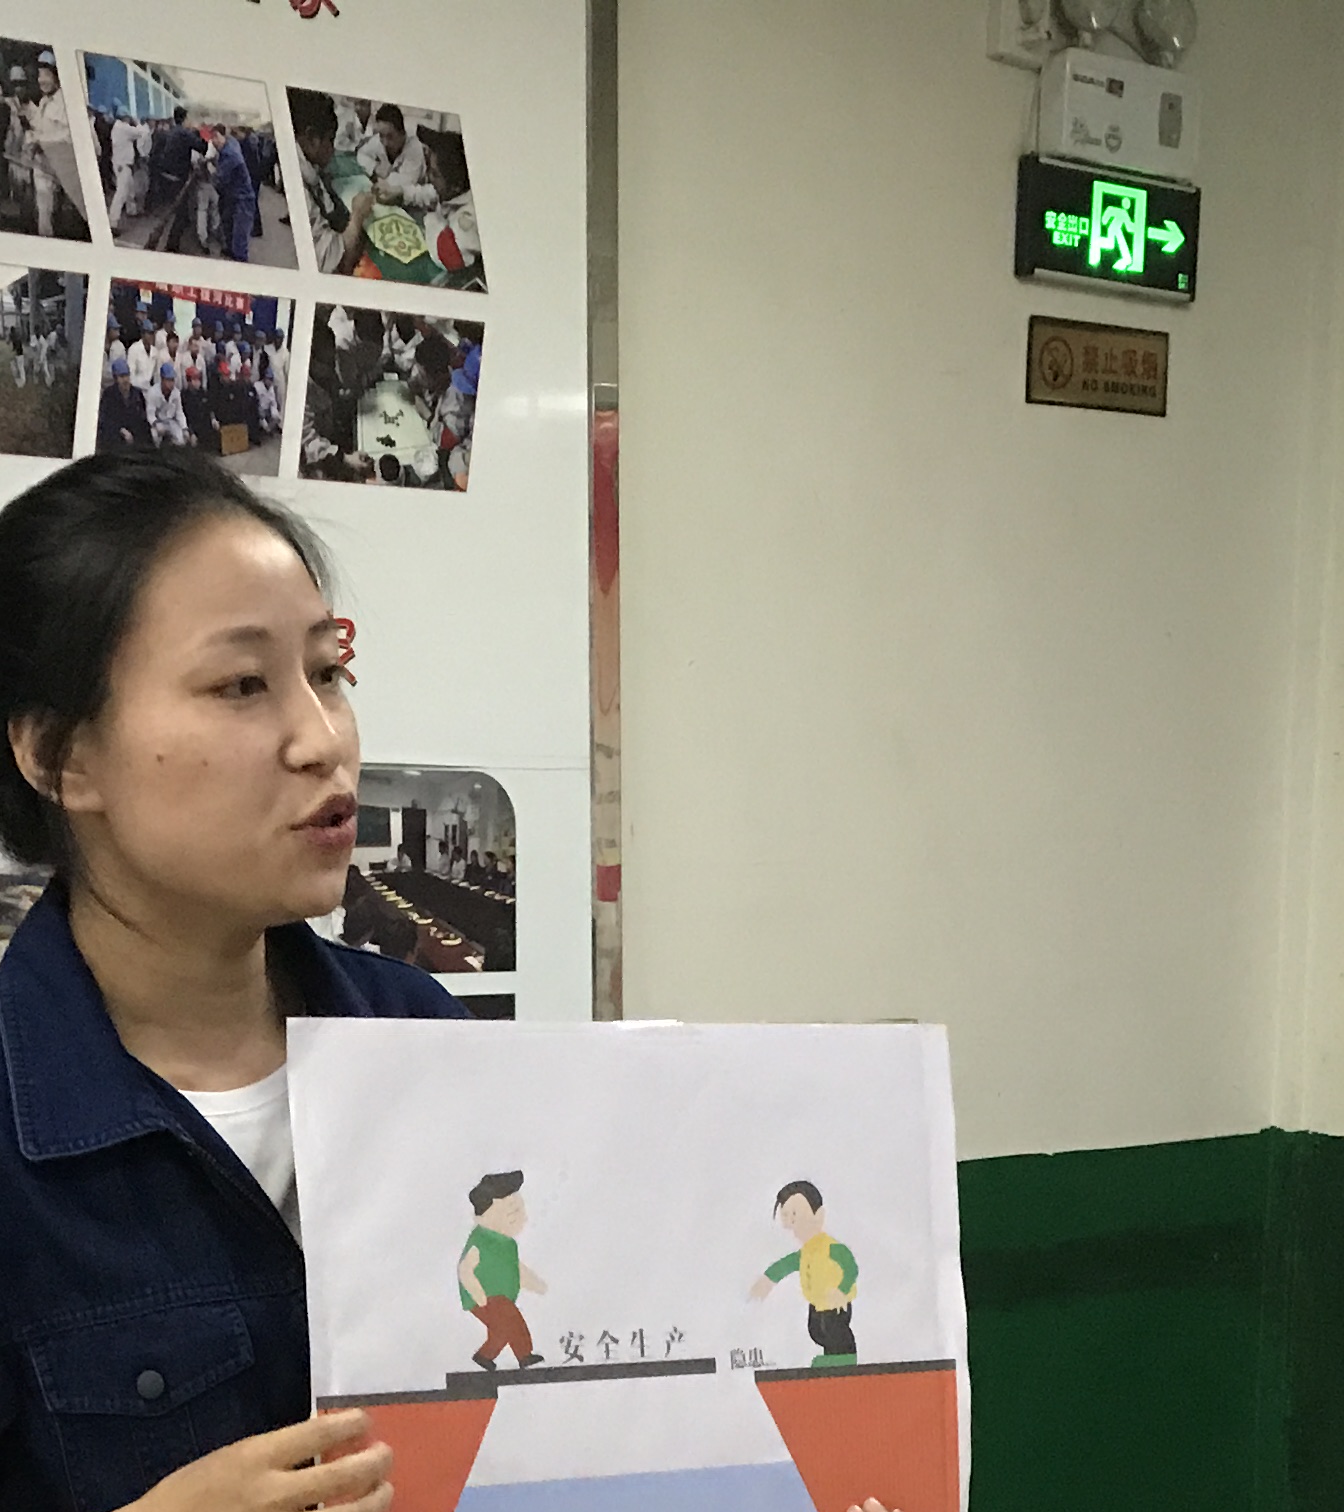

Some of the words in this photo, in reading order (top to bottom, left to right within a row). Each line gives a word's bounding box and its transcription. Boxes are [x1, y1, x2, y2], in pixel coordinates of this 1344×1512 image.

[1044, 210, 1090, 236] 安全出口
[1052, 231, 1082, 248] EXIT
[1081, 378, 1099, 392] NO
[1103, 380, 1158, 398] SMOKING
[559, 1325, 687, 1364] 安全生产
